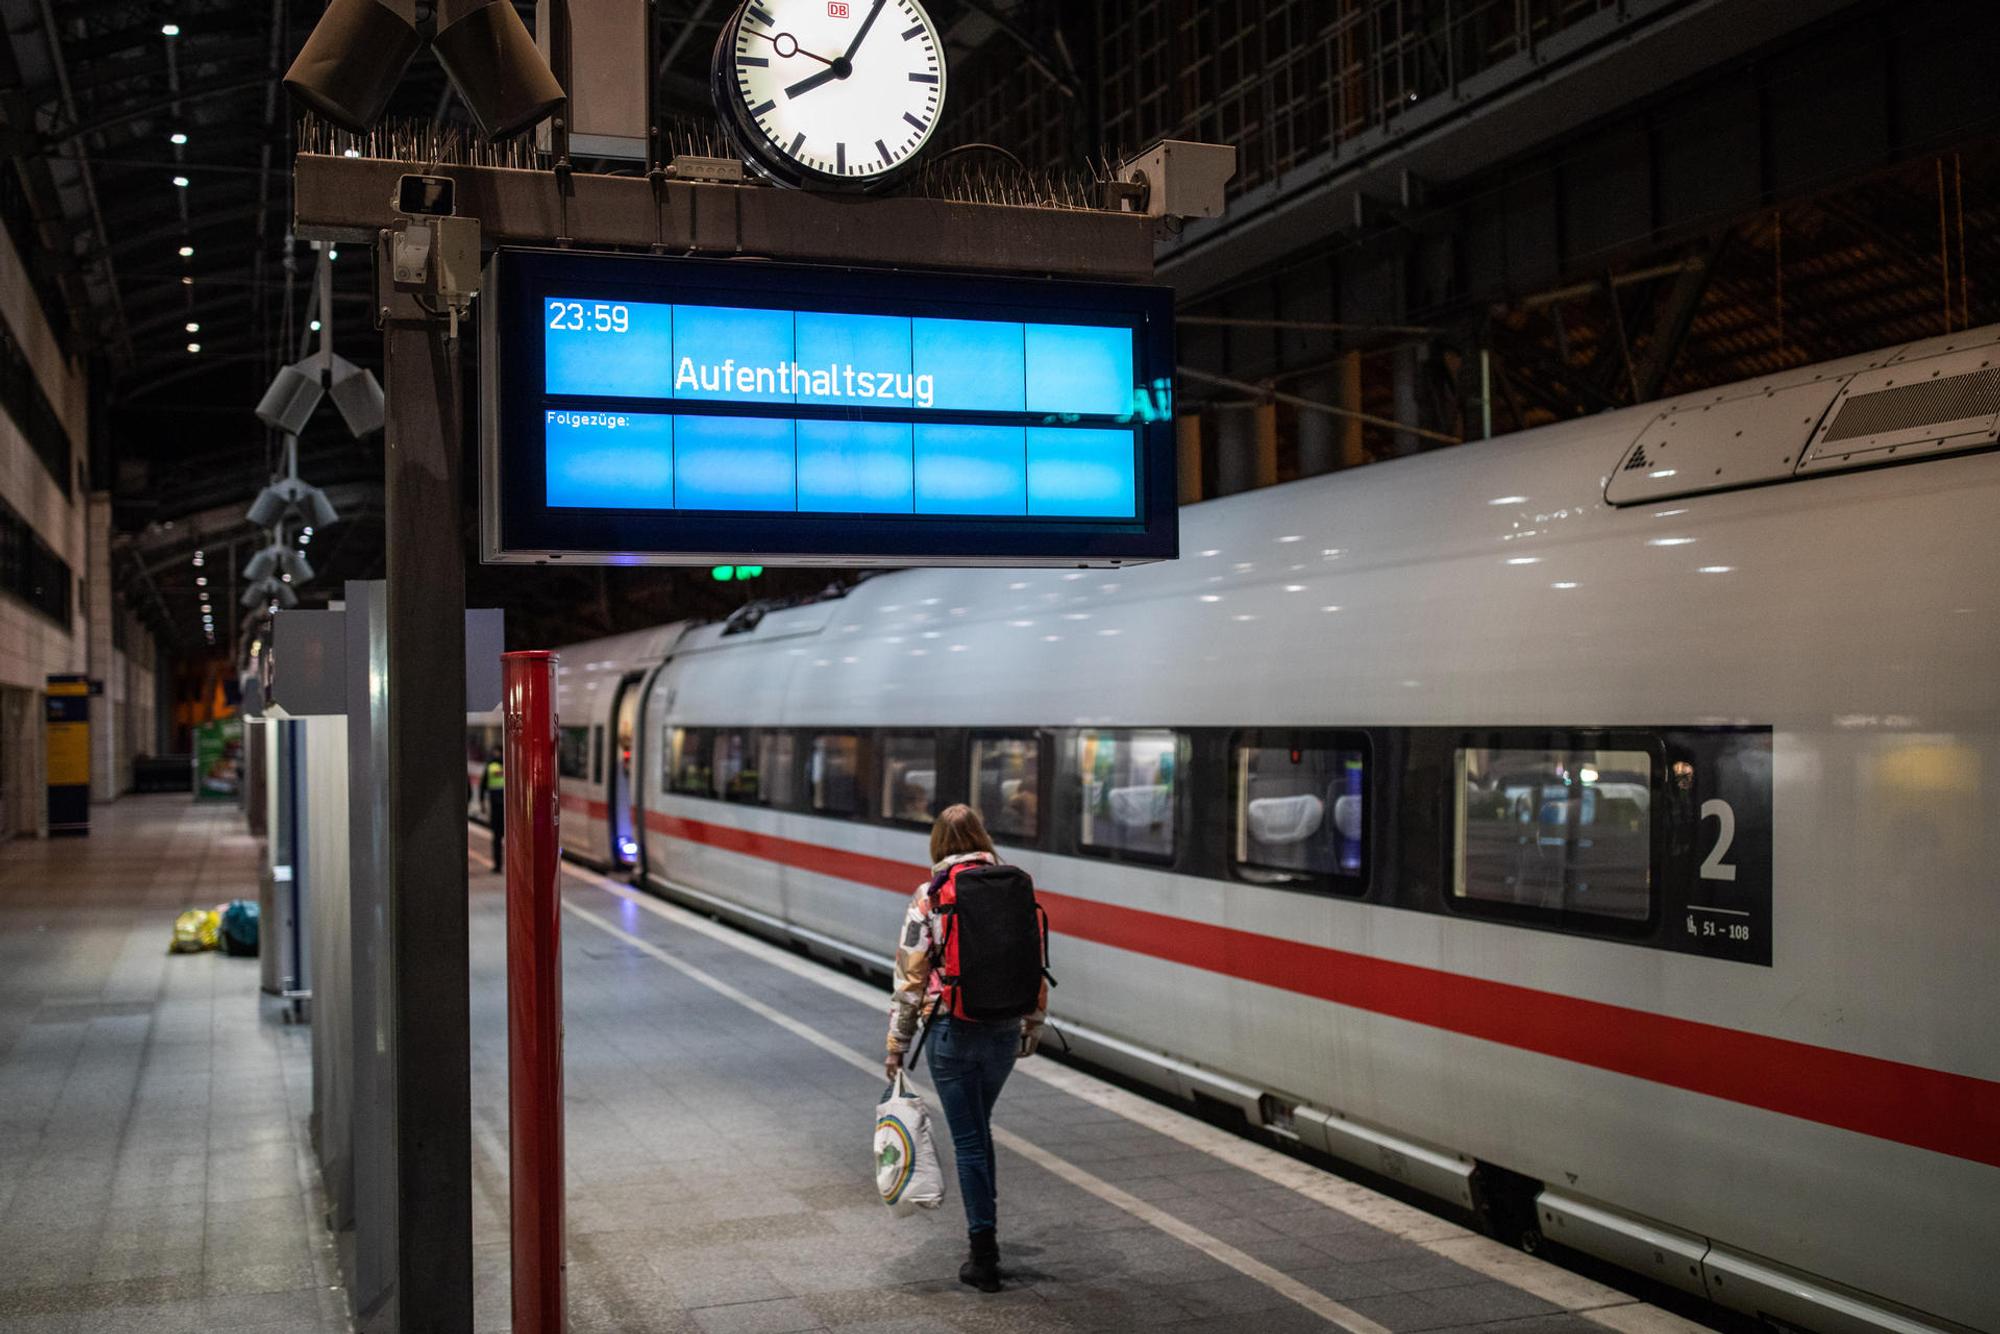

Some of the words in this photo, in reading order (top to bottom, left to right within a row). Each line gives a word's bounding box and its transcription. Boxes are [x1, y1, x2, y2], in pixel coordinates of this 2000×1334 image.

[830, 3, 847, 16] DB
[549, 302, 629, 333] 23:59
[675, 356, 934, 408] Aufenthaltszug
[547, 410, 630, 429] Folgezüge:
[1700, 799, 1736, 881] 2
[1703, 921, 1716, 936] 51
[1729, 924, 1749, 940] 108
